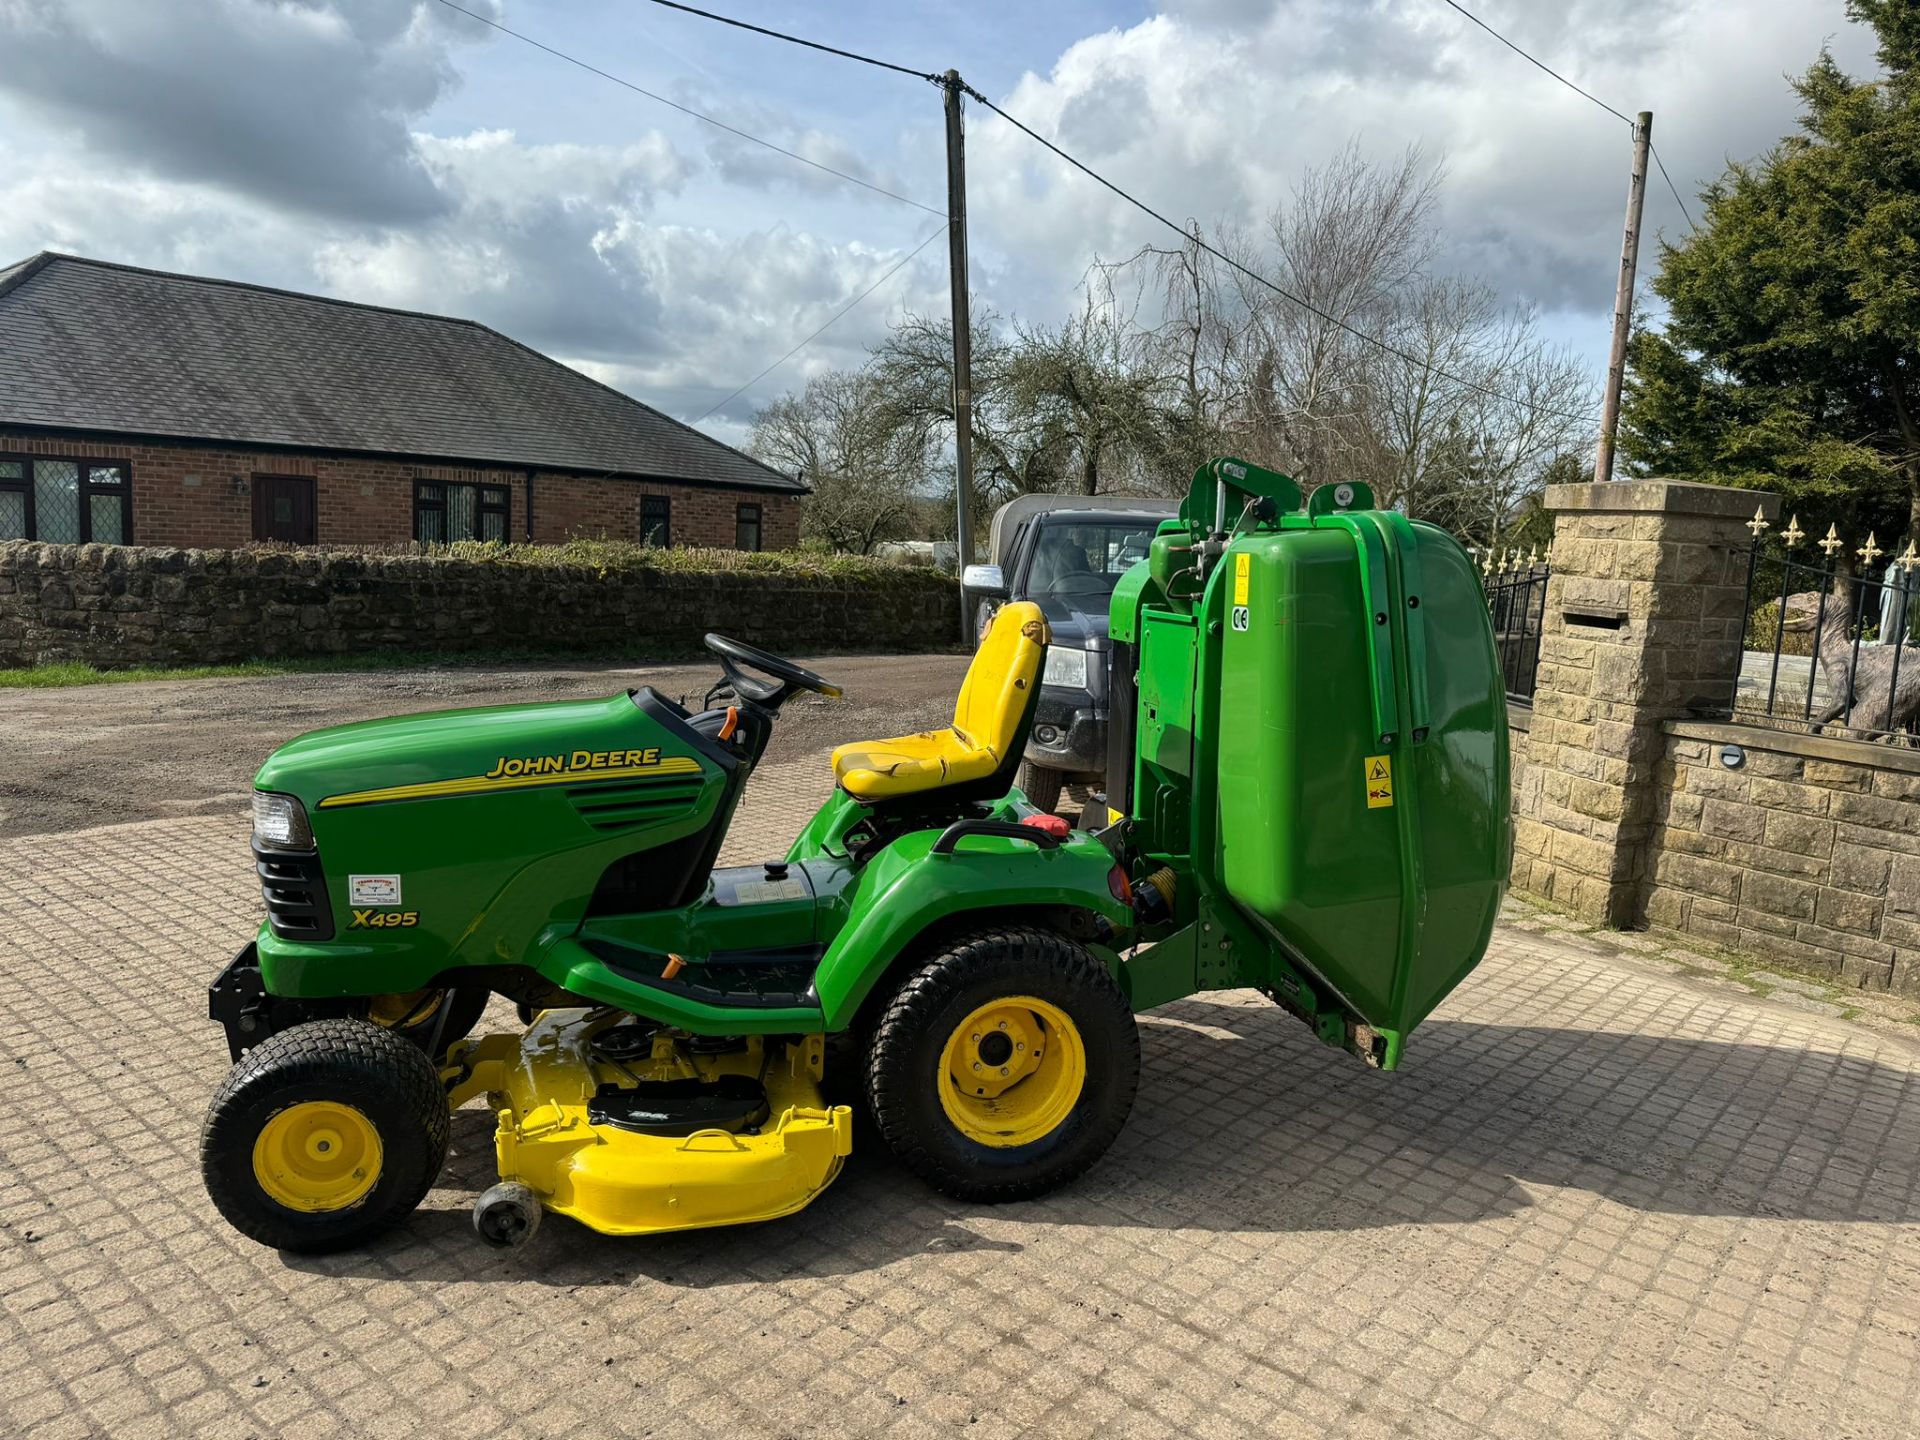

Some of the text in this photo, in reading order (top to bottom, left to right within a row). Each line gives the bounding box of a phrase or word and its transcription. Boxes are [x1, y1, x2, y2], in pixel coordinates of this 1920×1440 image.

[486, 748, 660, 778] JOHN DEERE
[349, 909, 418, 928] X495
